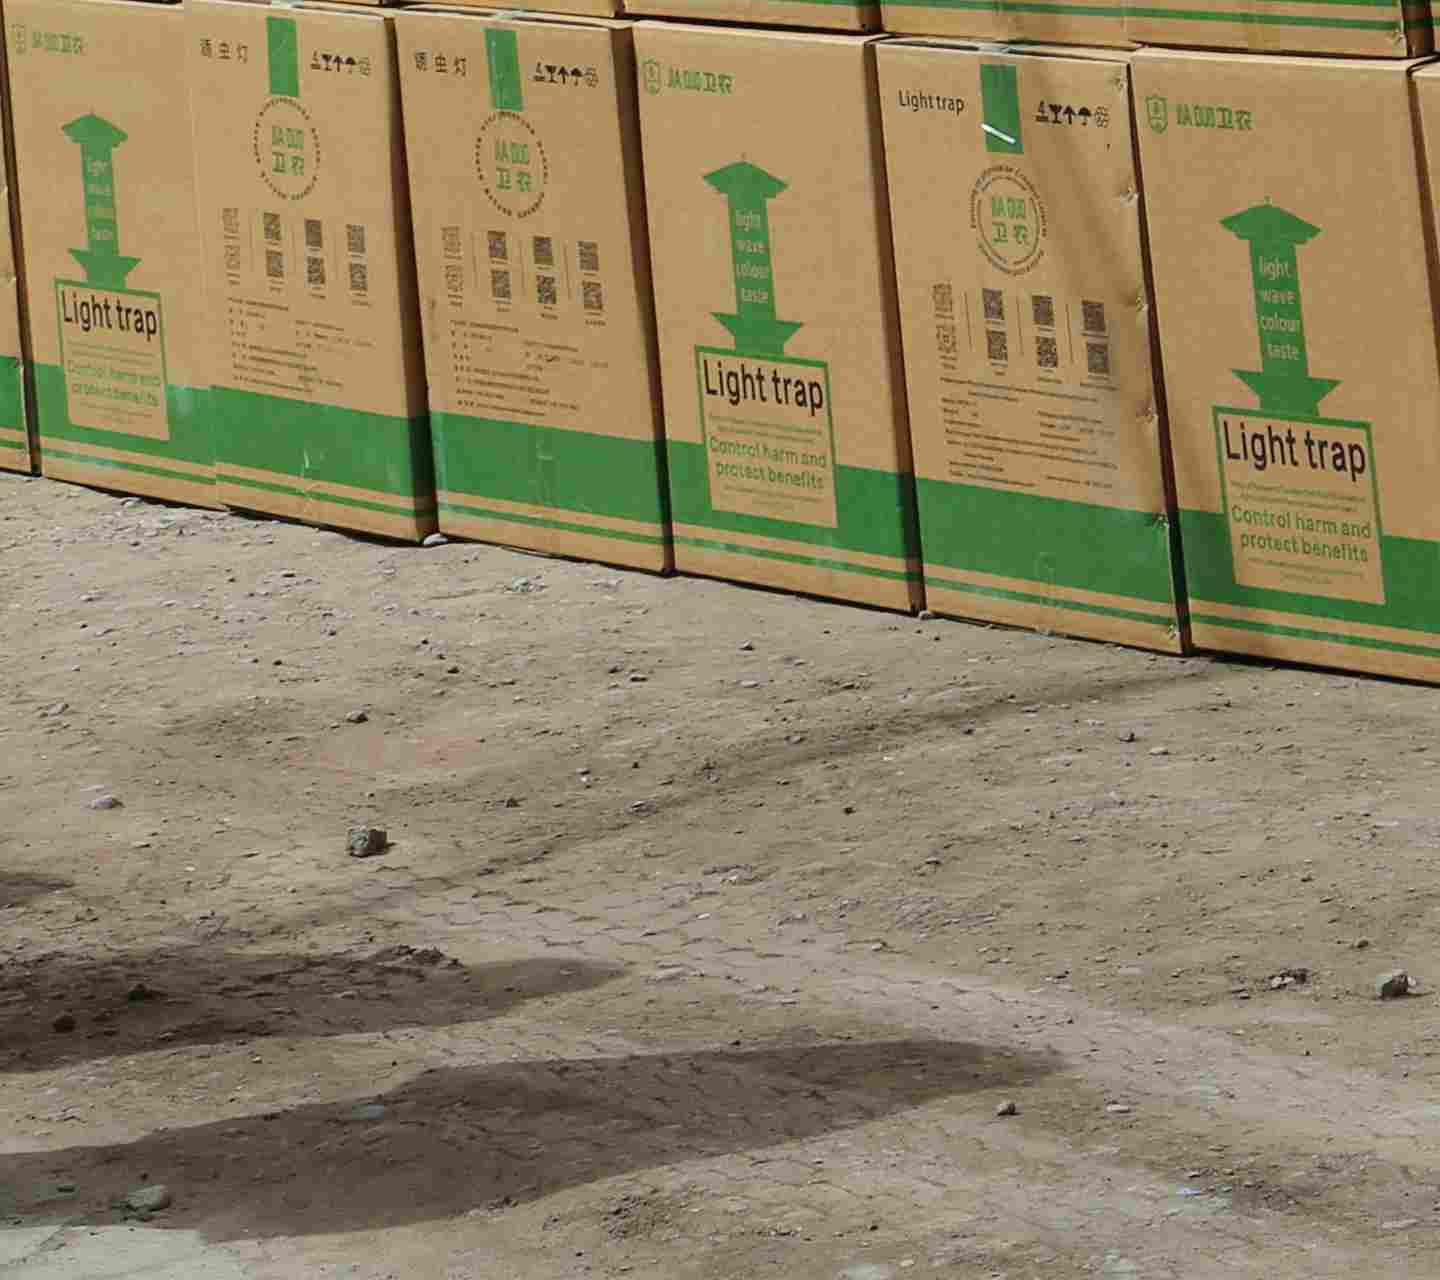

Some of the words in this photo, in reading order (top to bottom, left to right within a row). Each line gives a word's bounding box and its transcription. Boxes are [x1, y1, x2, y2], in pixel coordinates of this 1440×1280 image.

[898, 90, 930, 117] Light
[931, 93, 965, 116] trap
[62, 290, 113, 332] Light
[115, 298, 157, 342] trap
[704, 360, 767, 406] Light
[772, 369, 823, 416] trap
[1223, 419, 1298, 474] Light
[1305, 432, 1366, 482] trap
[1231, 504, 1290, 531] Control
[1295, 511, 1335, 538] harm
[1340, 516, 1371, 539] and
[1240, 529, 1297, 556] protect
[1301, 537, 1368, 563] benefits
